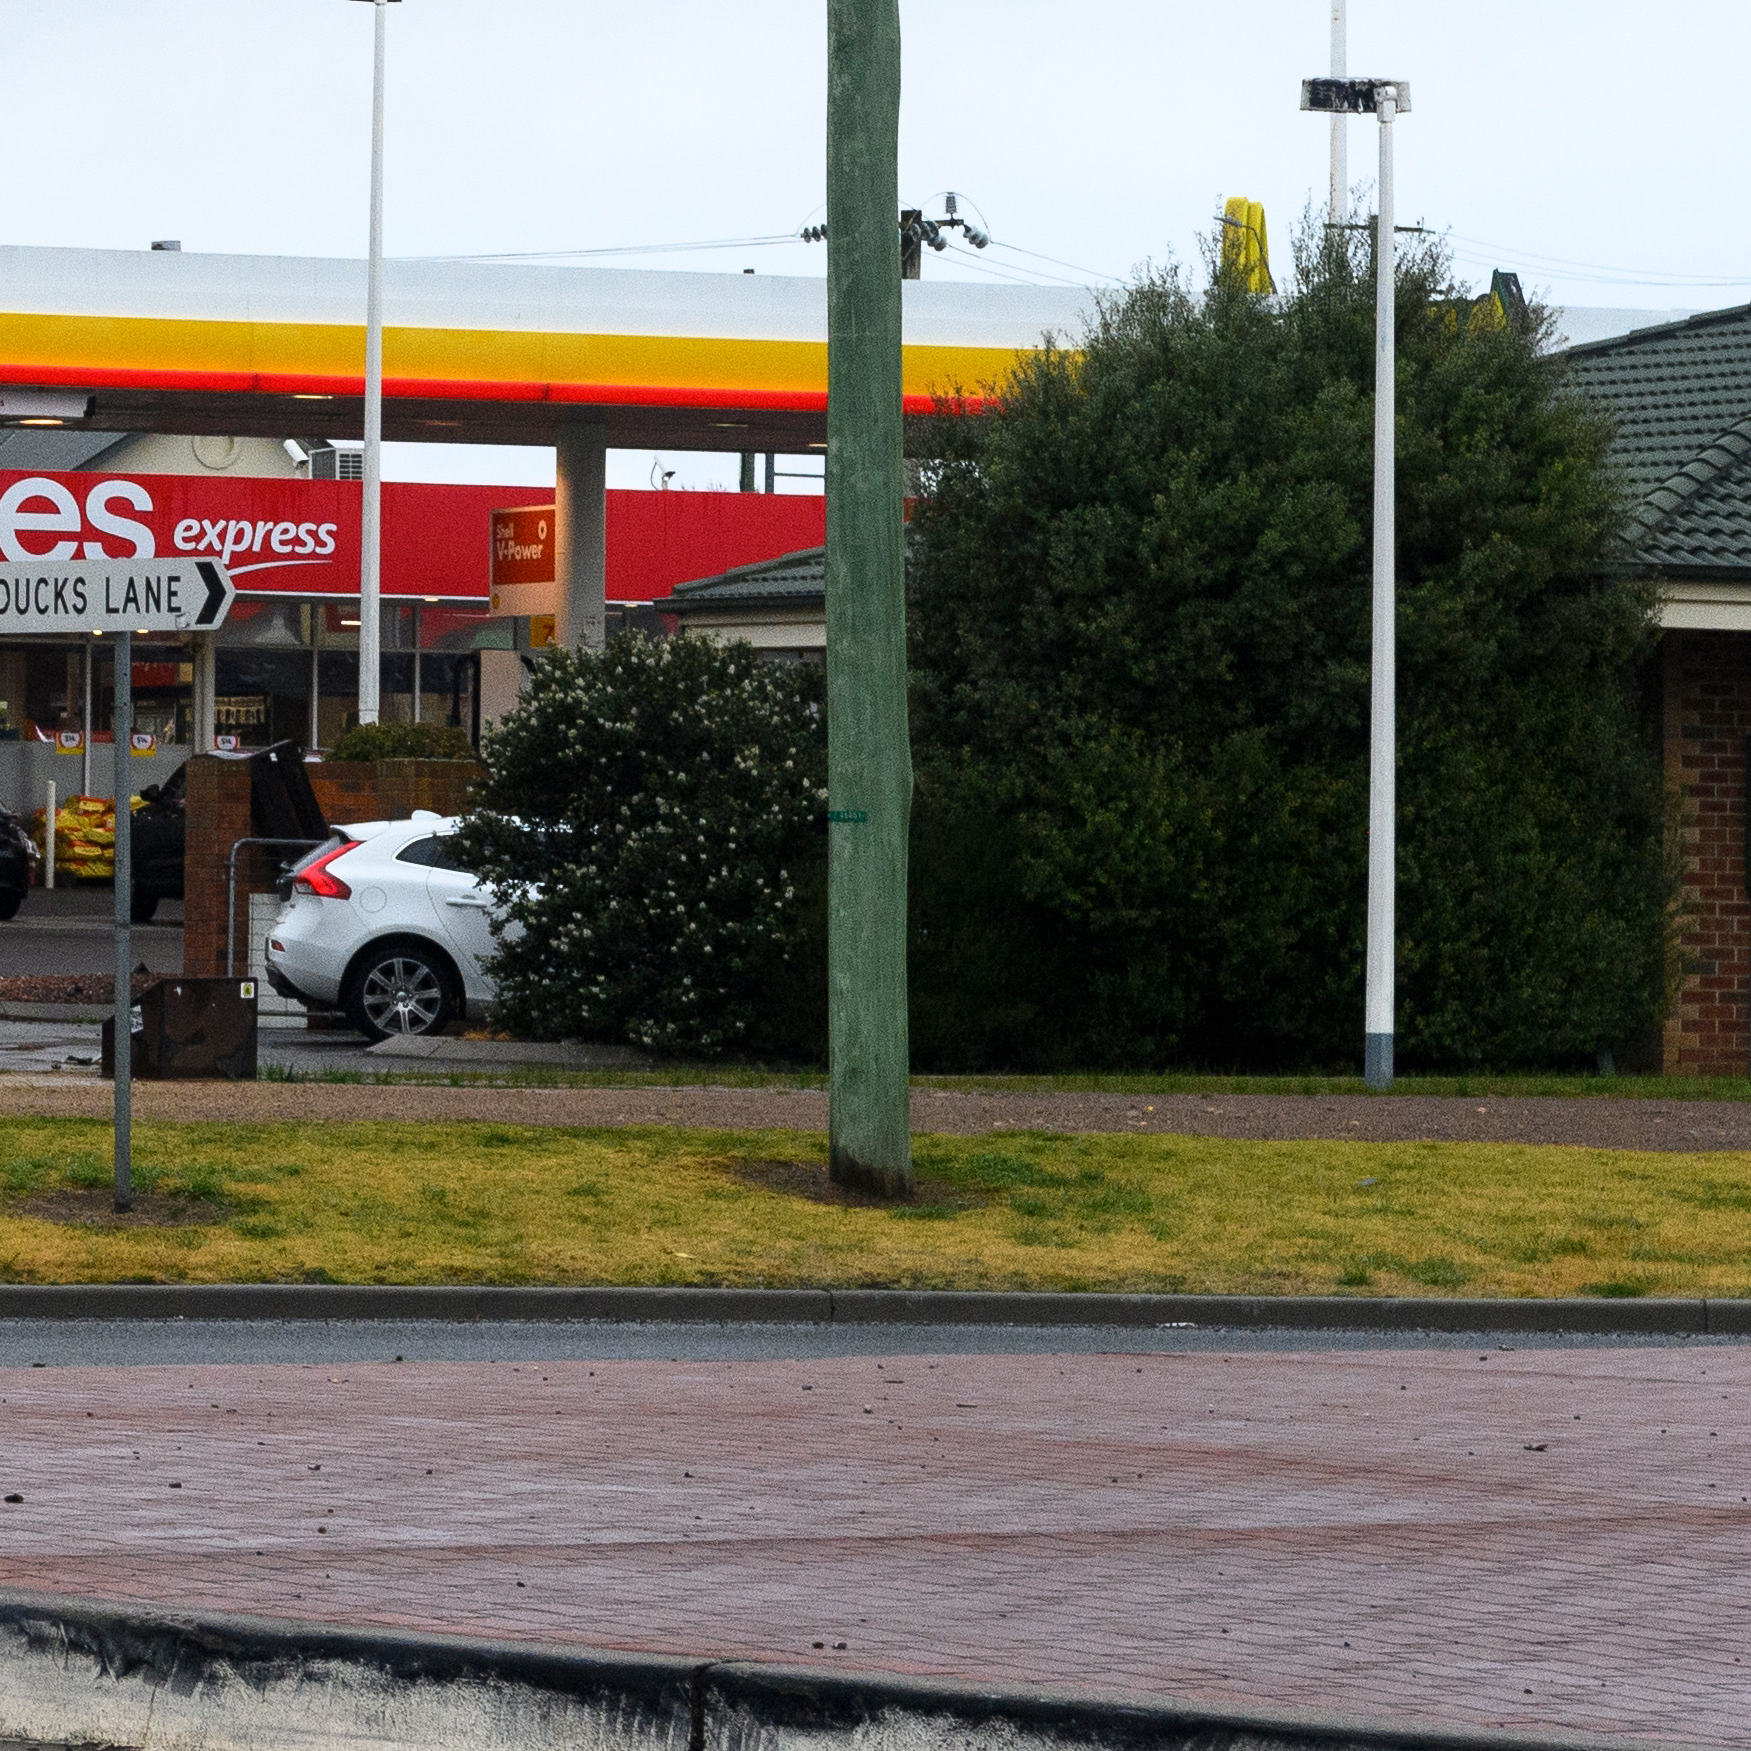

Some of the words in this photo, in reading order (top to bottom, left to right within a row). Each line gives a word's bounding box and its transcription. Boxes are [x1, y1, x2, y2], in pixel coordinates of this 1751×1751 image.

[173, 517, 338, 561] express
[496, 540, 544, 561] V-Power
[105, 575, 183, 615] LANE
